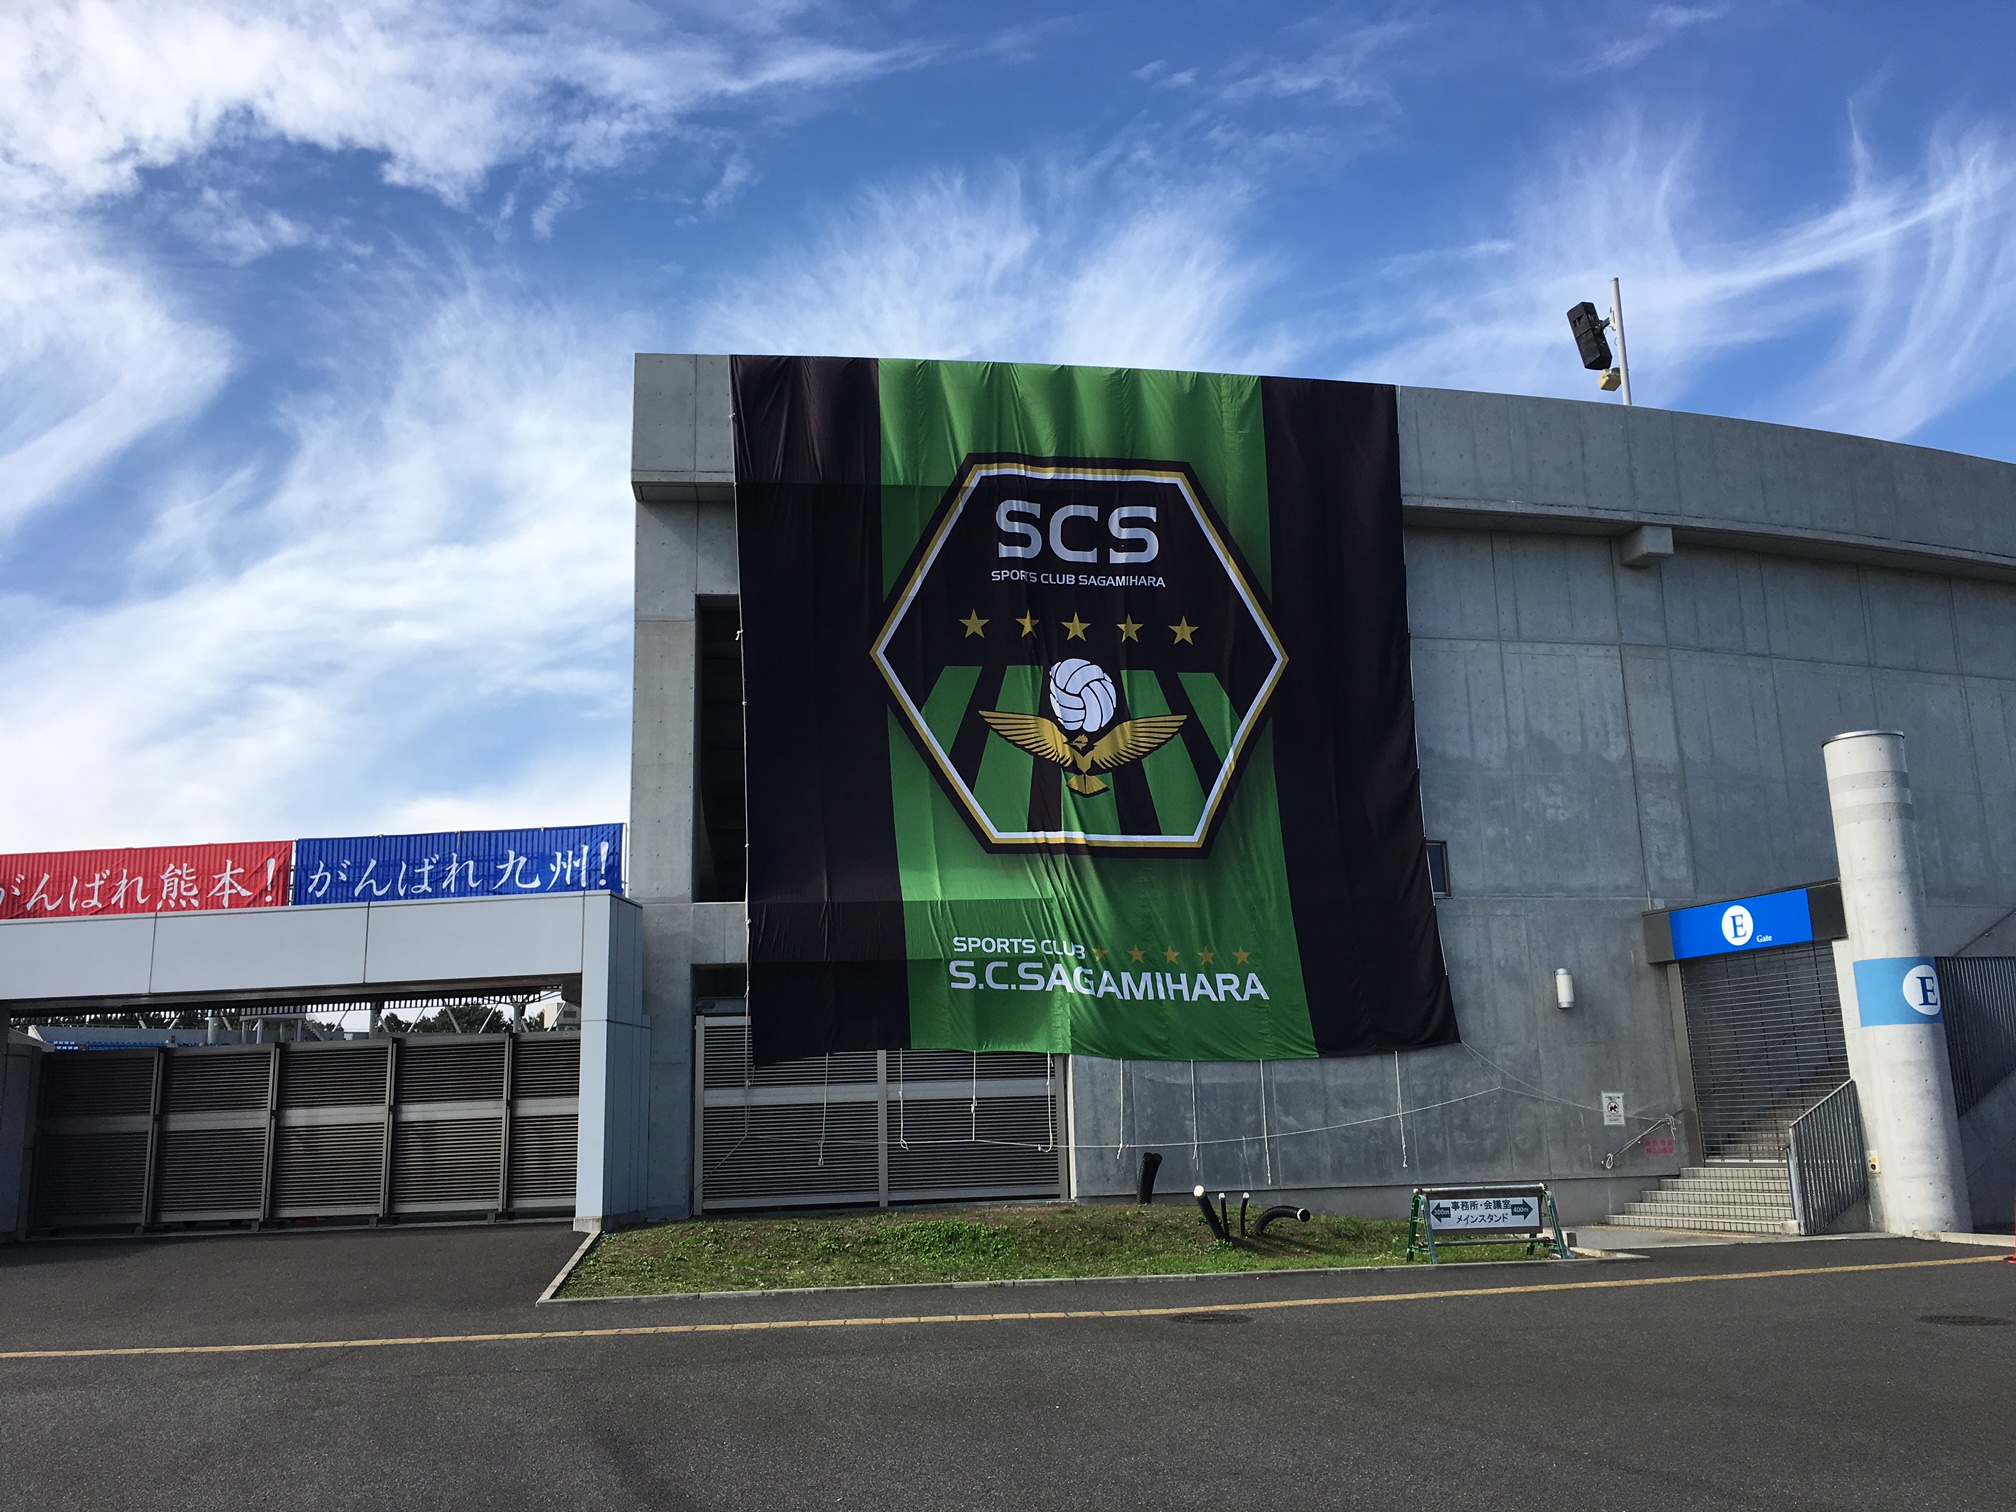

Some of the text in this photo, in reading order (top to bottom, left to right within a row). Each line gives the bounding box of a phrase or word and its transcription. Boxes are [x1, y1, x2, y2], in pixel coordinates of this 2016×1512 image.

[995, 499, 1160, 564] SCS
[990, 569, 1166, 588] SPORTS CLUB SAGAMIHARA
[1729, 914, 1747, 939] E
[1756, 933, 1773, 944] Gate
[952, 936, 1086, 960] SPORTS CLUB
[949, 960, 1270, 1002] S.C.SAGAMIHARA
[1916, 976, 1938, 1006] E
[1456, 1213, 1508, 1225] メインスタンド
